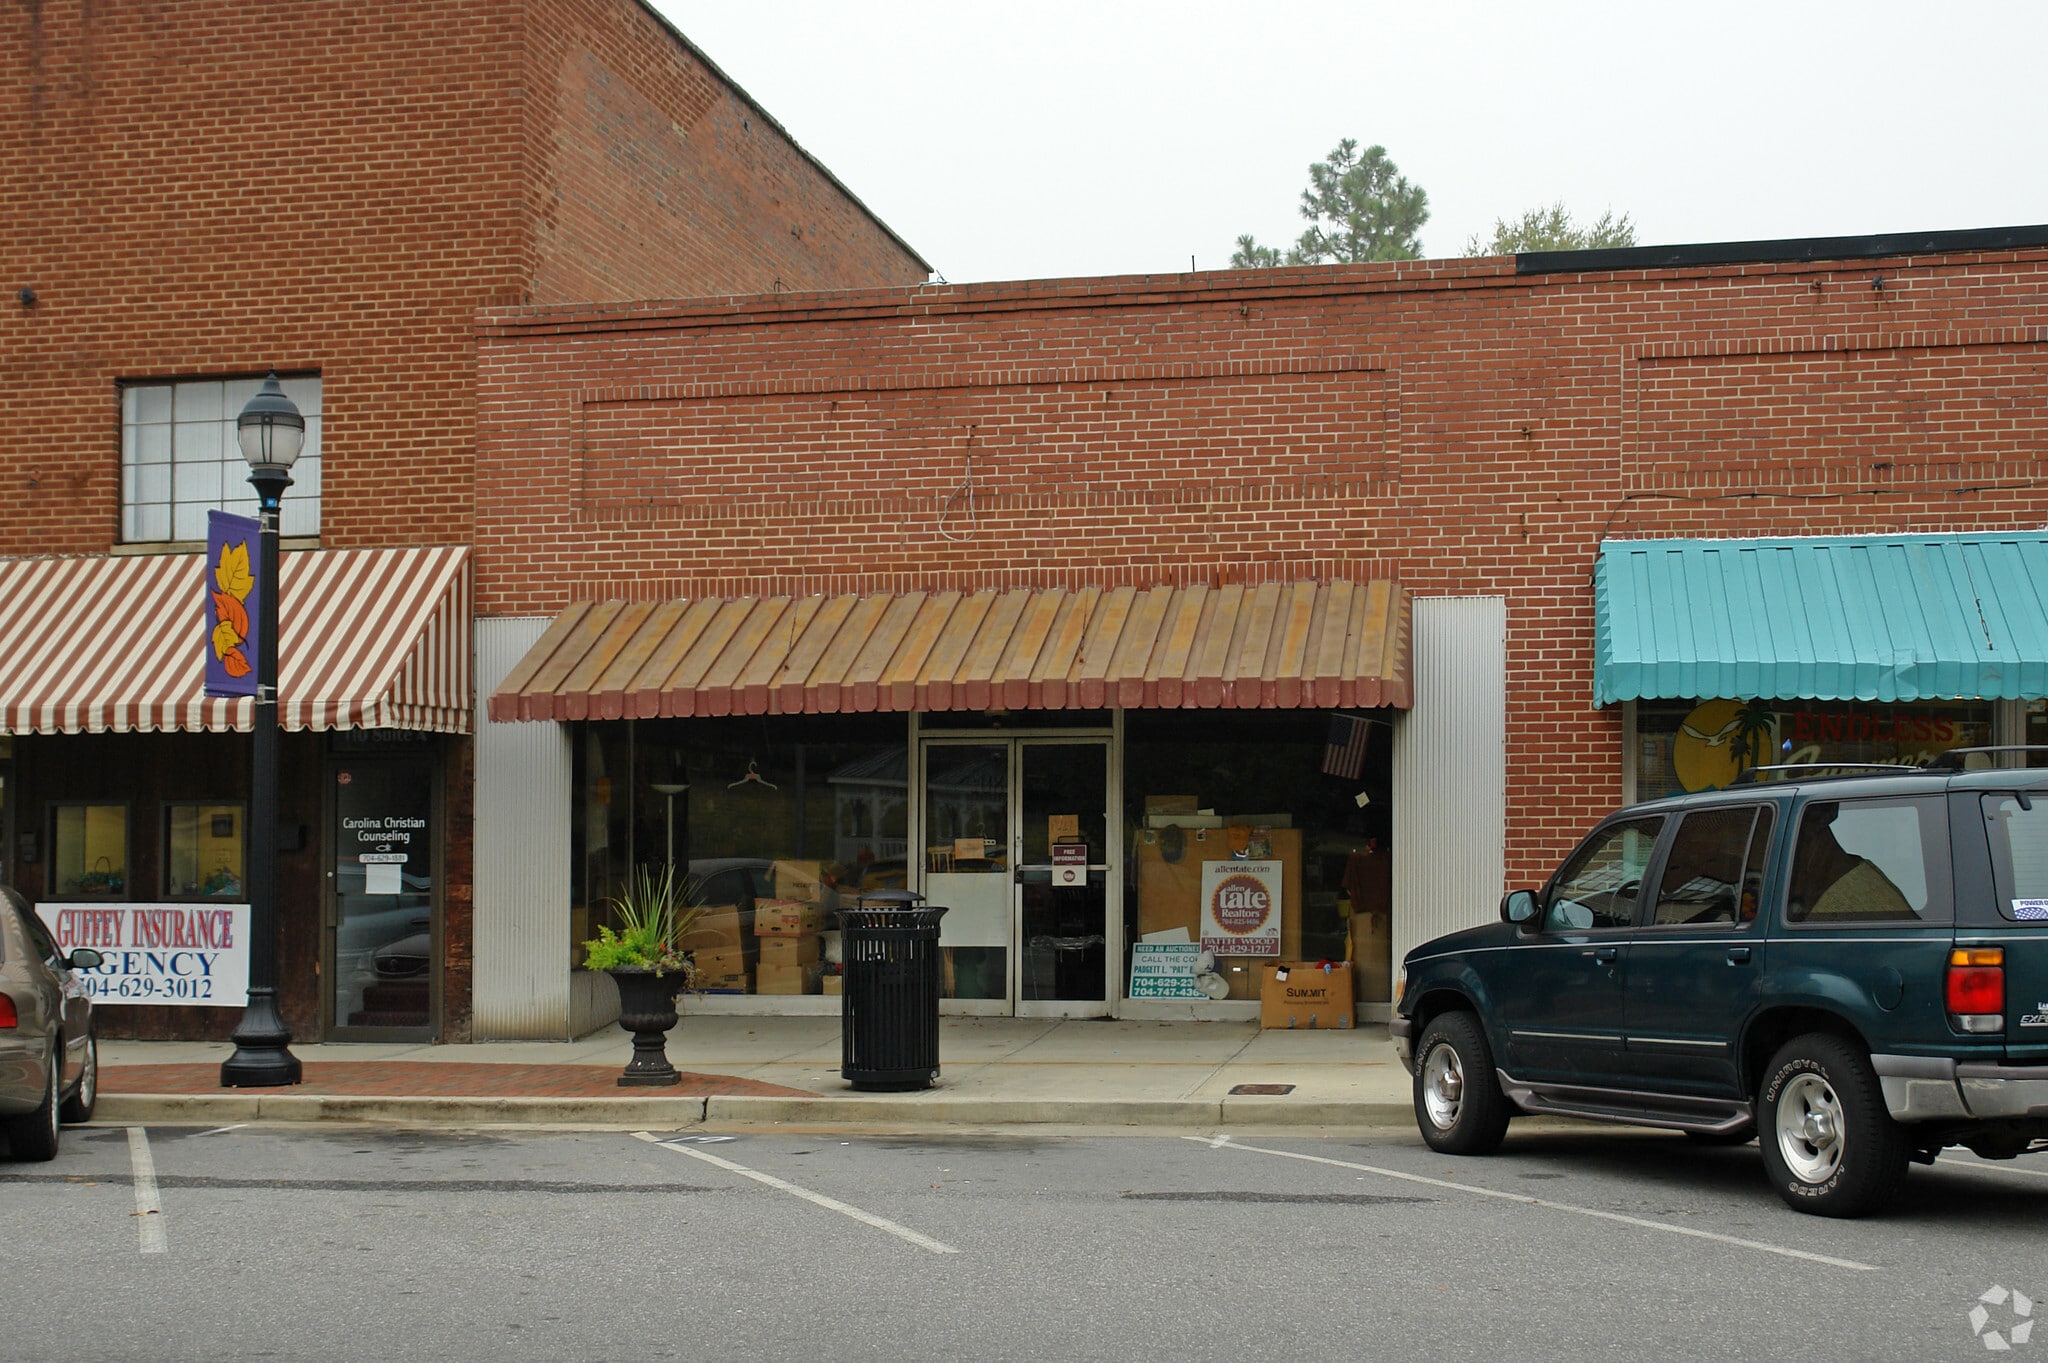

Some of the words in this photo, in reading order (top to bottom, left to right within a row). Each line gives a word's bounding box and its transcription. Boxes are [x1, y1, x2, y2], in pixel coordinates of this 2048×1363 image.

[1795, 712, 1954, 742] ENDLESS
[343, 817, 381, 828] Carolina
[384, 817, 425, 828] Christian
[357, 830, 411, 844] Counseling
[1214, 865, 1270, 873] allentate.com
[1226, 884, 1245, 892] allen
[1218, 888, 1267, 909] tate
[1221, 909, 1260, 918] Realtors
[56, 909, 125, 948] GUFFEY
[131, 909, 233, 949] INSURANCE
[1137, 945, 1154, 953] NEED
[1155, 945, 1165, 953] AN
[1166, 945, 1200, 953] AUCTIONEE
[1207, 945, 1272, 954] 704-829-1217
[80, 951, 219, 976] GENCY
[1134, 965, 1160, 974] PADGETT
[80, 977, 212, 998] 04-629-3012
[1134, 978, 1194, 987] 704-629-23
[1286, 987, 1326, 998] SUMMIT
[1415, 1031, 1450, 1077] UNIROYAL
[1766, 1059, 1830, 1103] UNIROYAL
[1788, 1164, 1845, 1197] LAREDO
